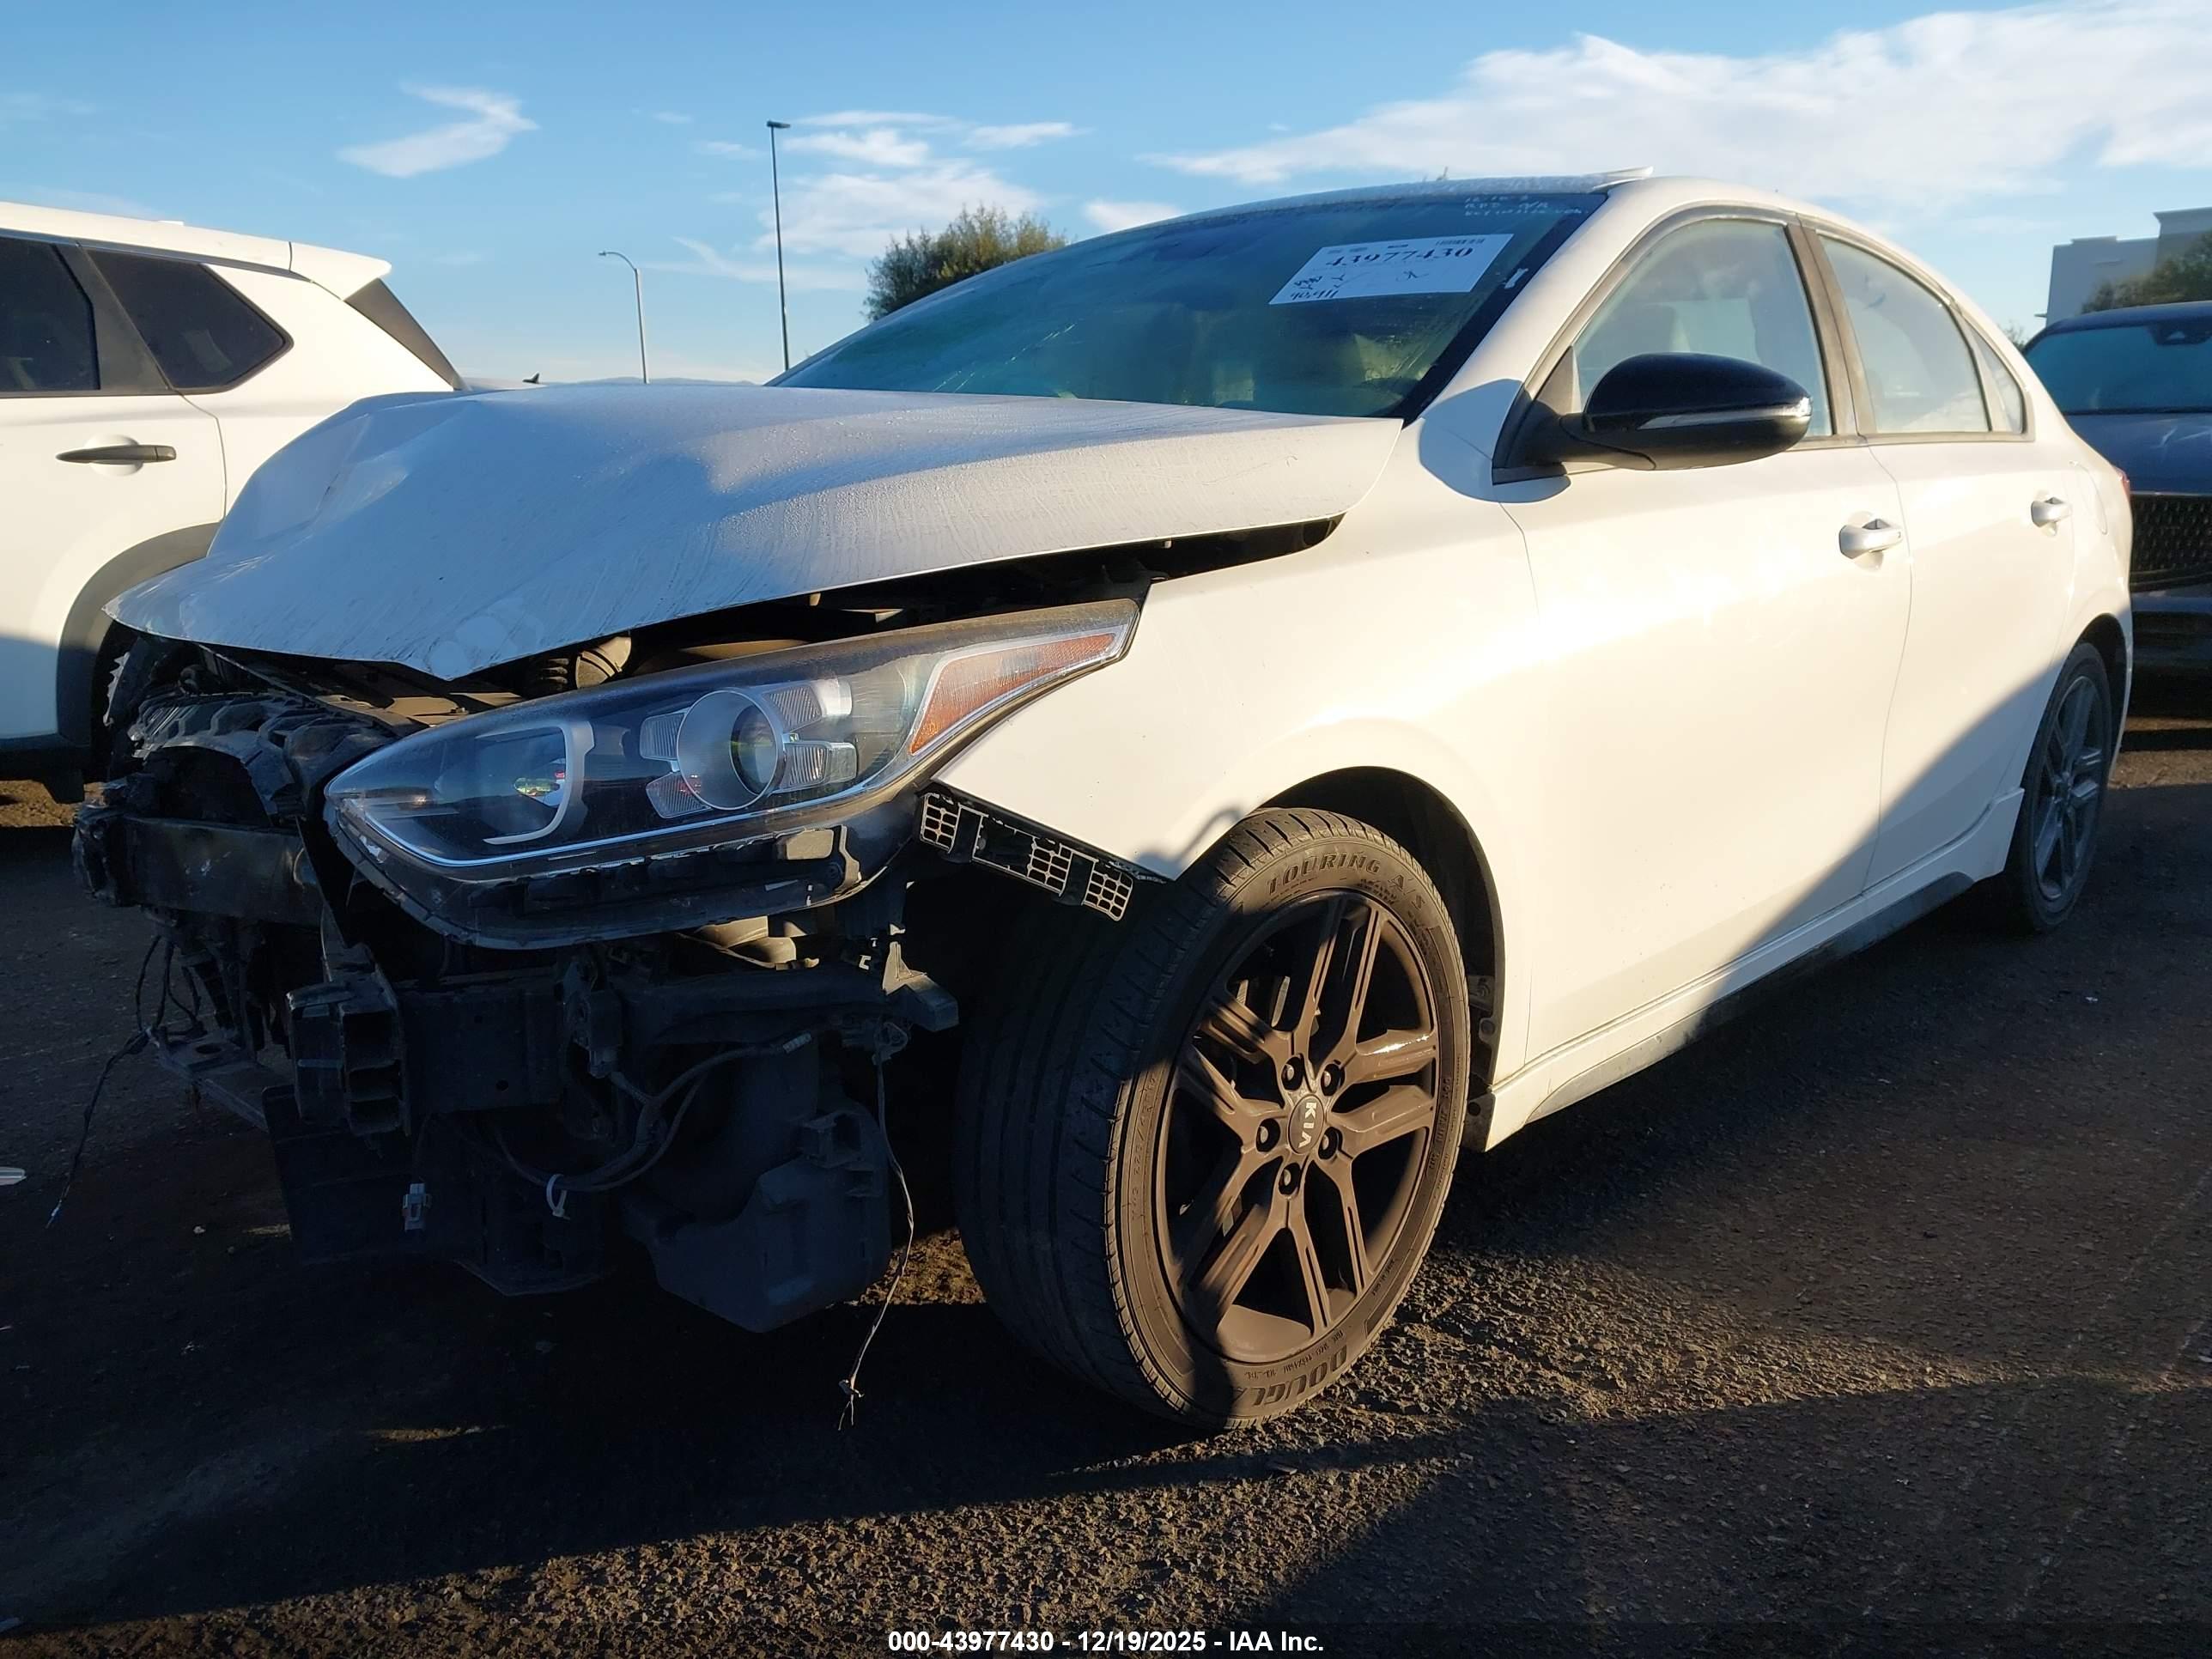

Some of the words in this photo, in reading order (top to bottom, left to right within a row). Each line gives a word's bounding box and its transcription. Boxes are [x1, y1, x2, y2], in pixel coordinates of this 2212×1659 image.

[1325, 246, 1474, 267] 43977430
[1266, 851, 1382, 895] TOURING
[1297, 1102, 1317, 1149] KIA
